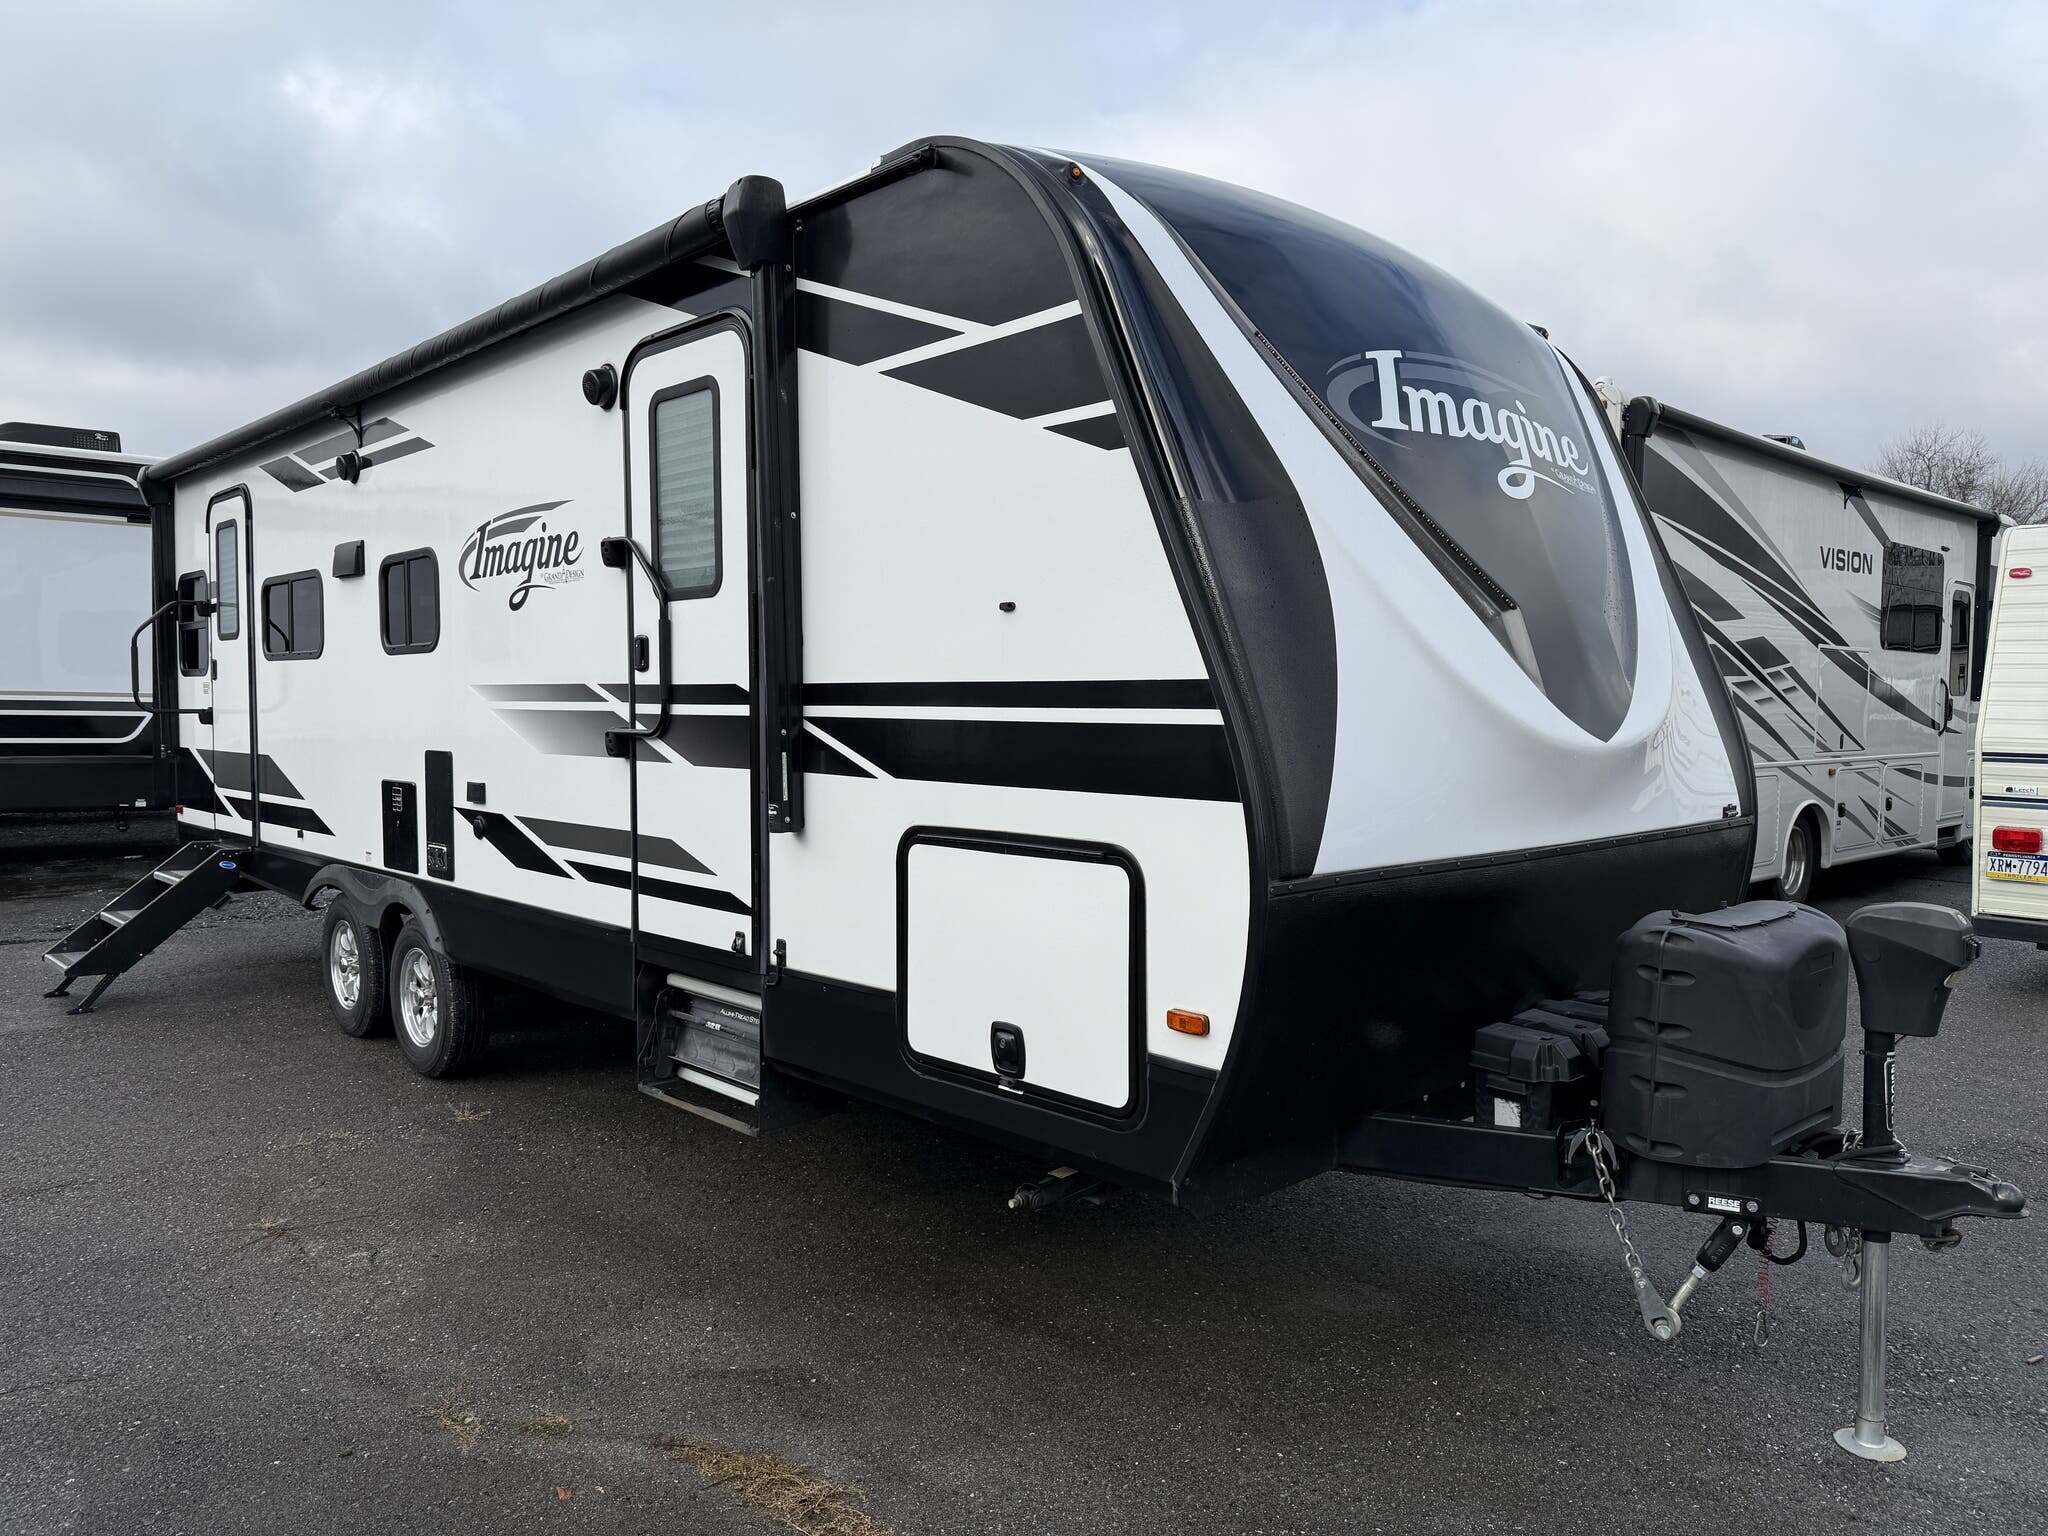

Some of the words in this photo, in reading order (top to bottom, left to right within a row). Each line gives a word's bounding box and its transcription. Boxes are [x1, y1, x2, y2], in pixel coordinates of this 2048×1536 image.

[1365, 349, 1589, 500] Imagine
[469, 520, 584, 611] Imagine
[1820, 546, 1873, 575] VISION
[1708, 1196, 1741, 1208] REESE
